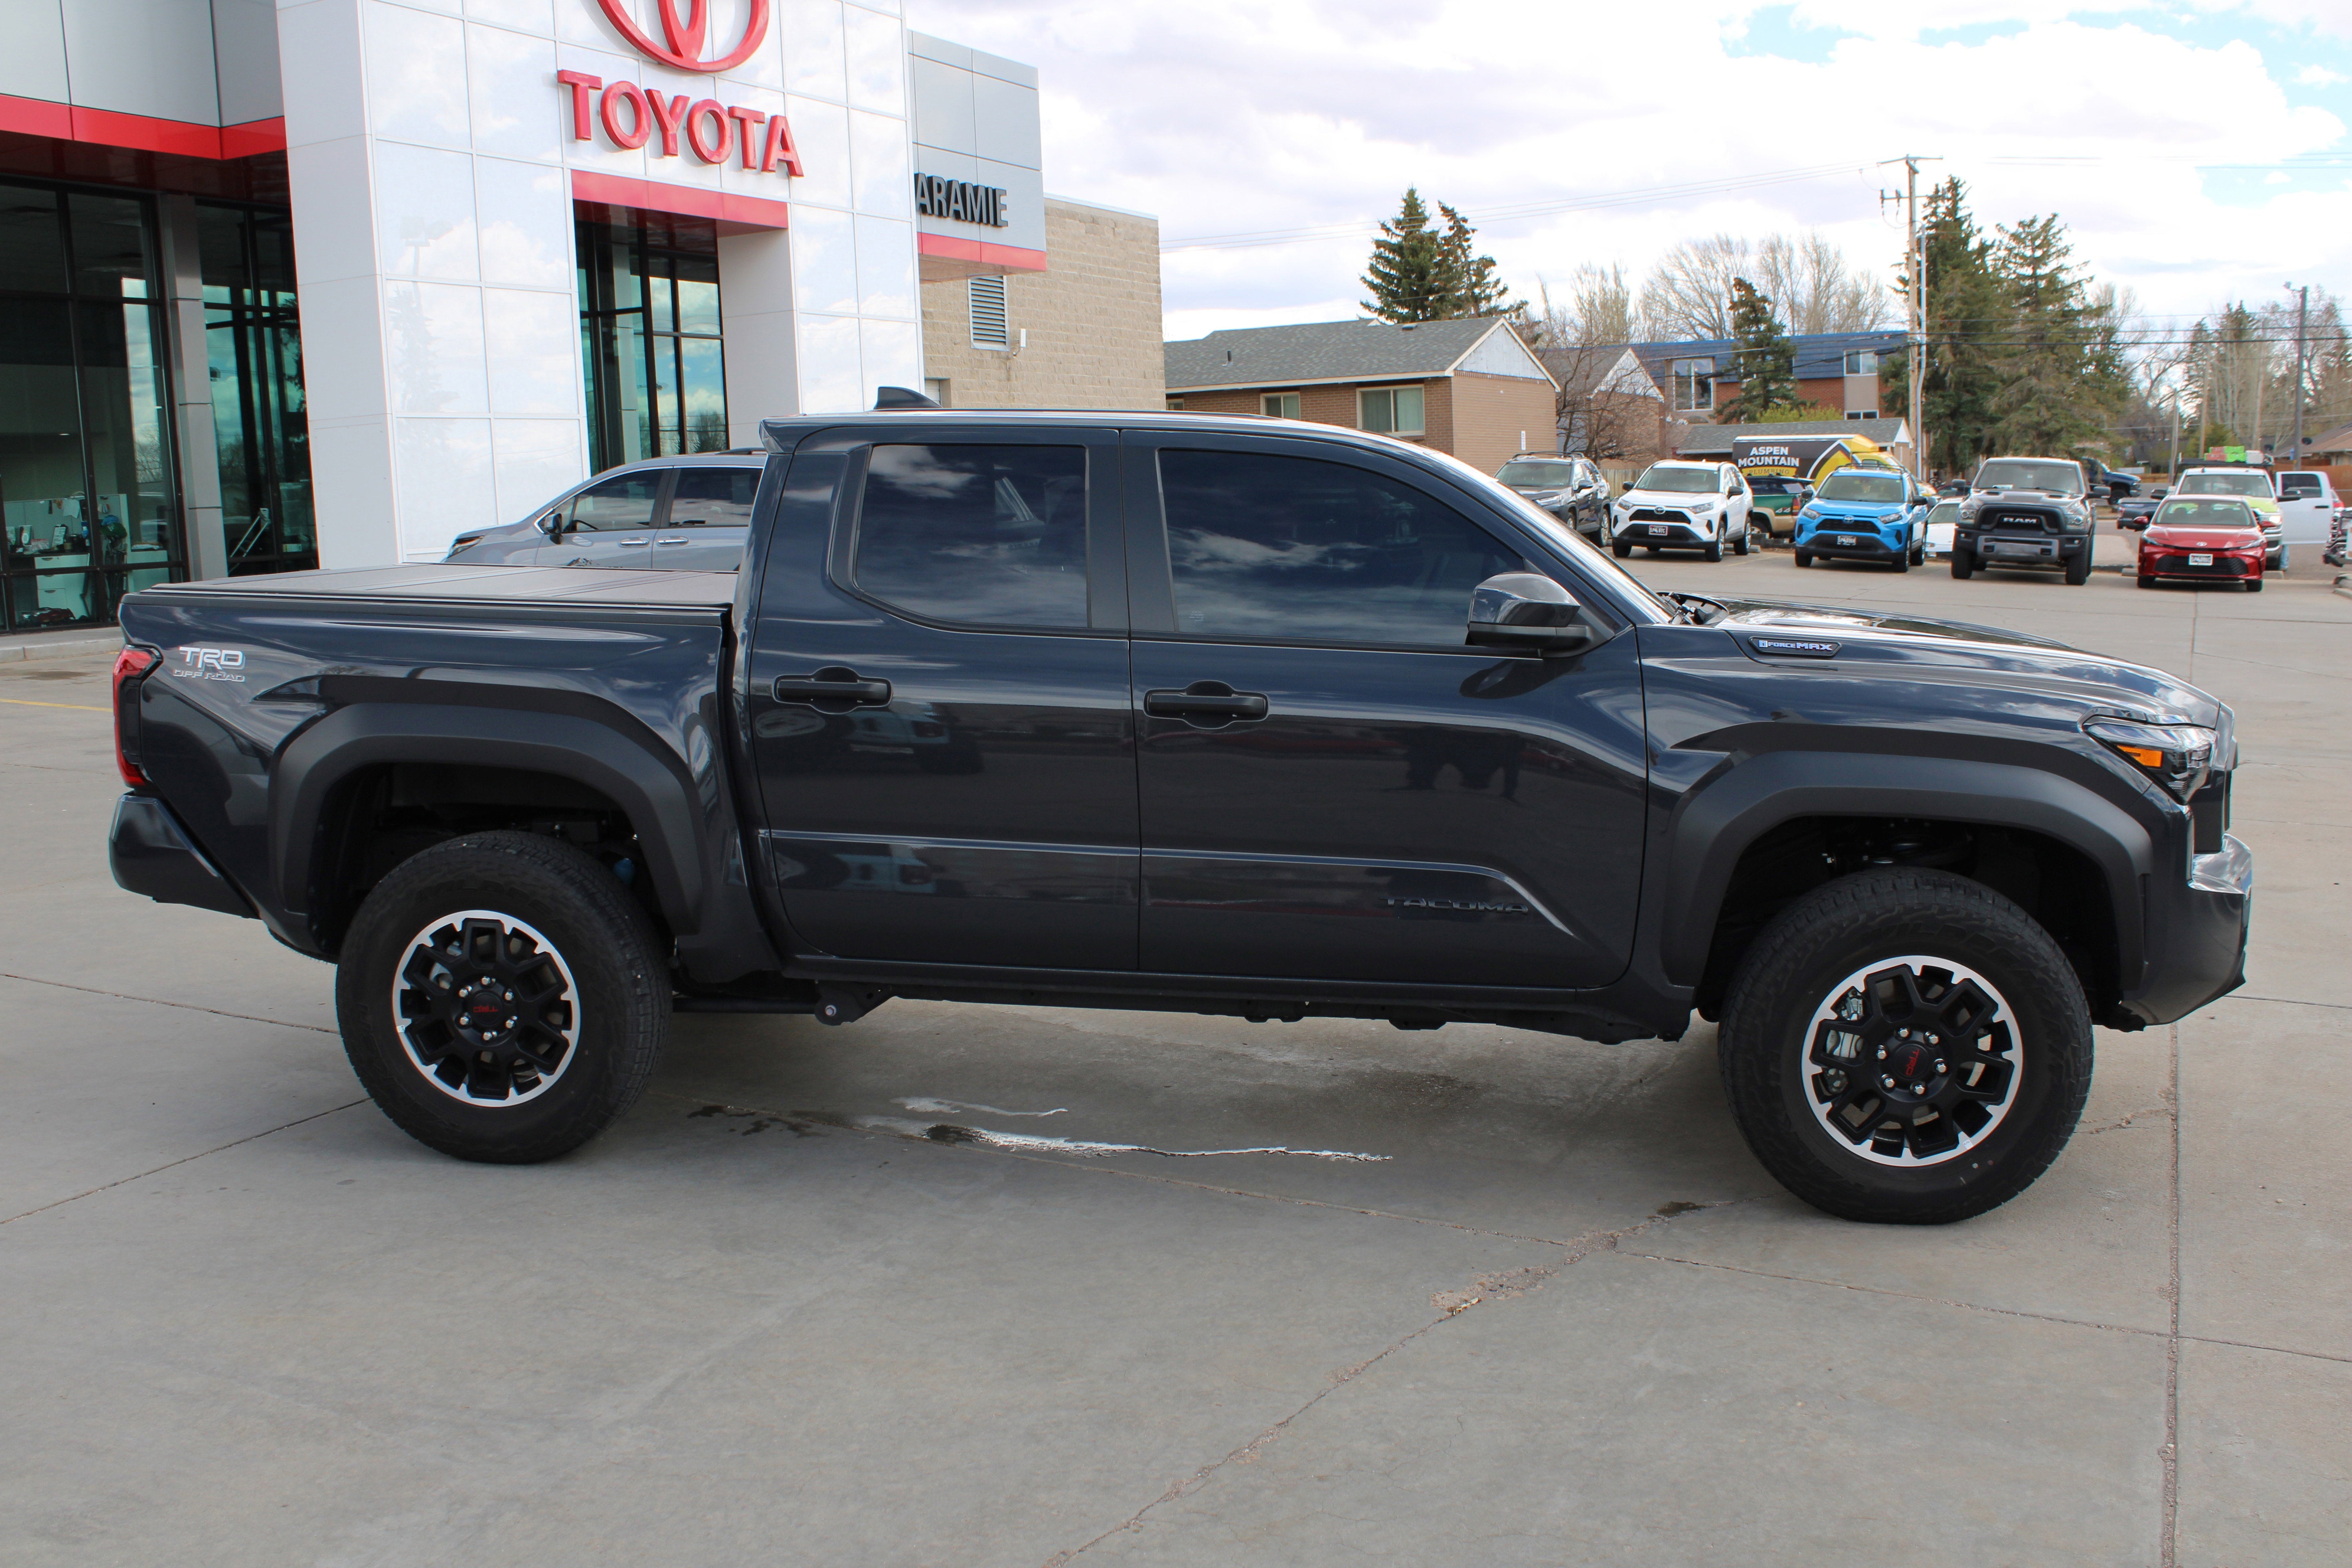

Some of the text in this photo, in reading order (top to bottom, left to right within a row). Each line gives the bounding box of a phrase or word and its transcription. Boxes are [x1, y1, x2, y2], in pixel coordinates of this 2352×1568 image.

[557, 69, 804, 177] TOYOTA
[1750, 446, 1789, 456] ASPEN
[1738, 457, 1800, 468] MOUNTAIN
[178, 647, 244, 670] TRD
[173, 669, 246, 682] OFF ROAD
[1379, 896, 1529, 915] TACOMA
[1906, 1049, 1920, 1076] TRD
